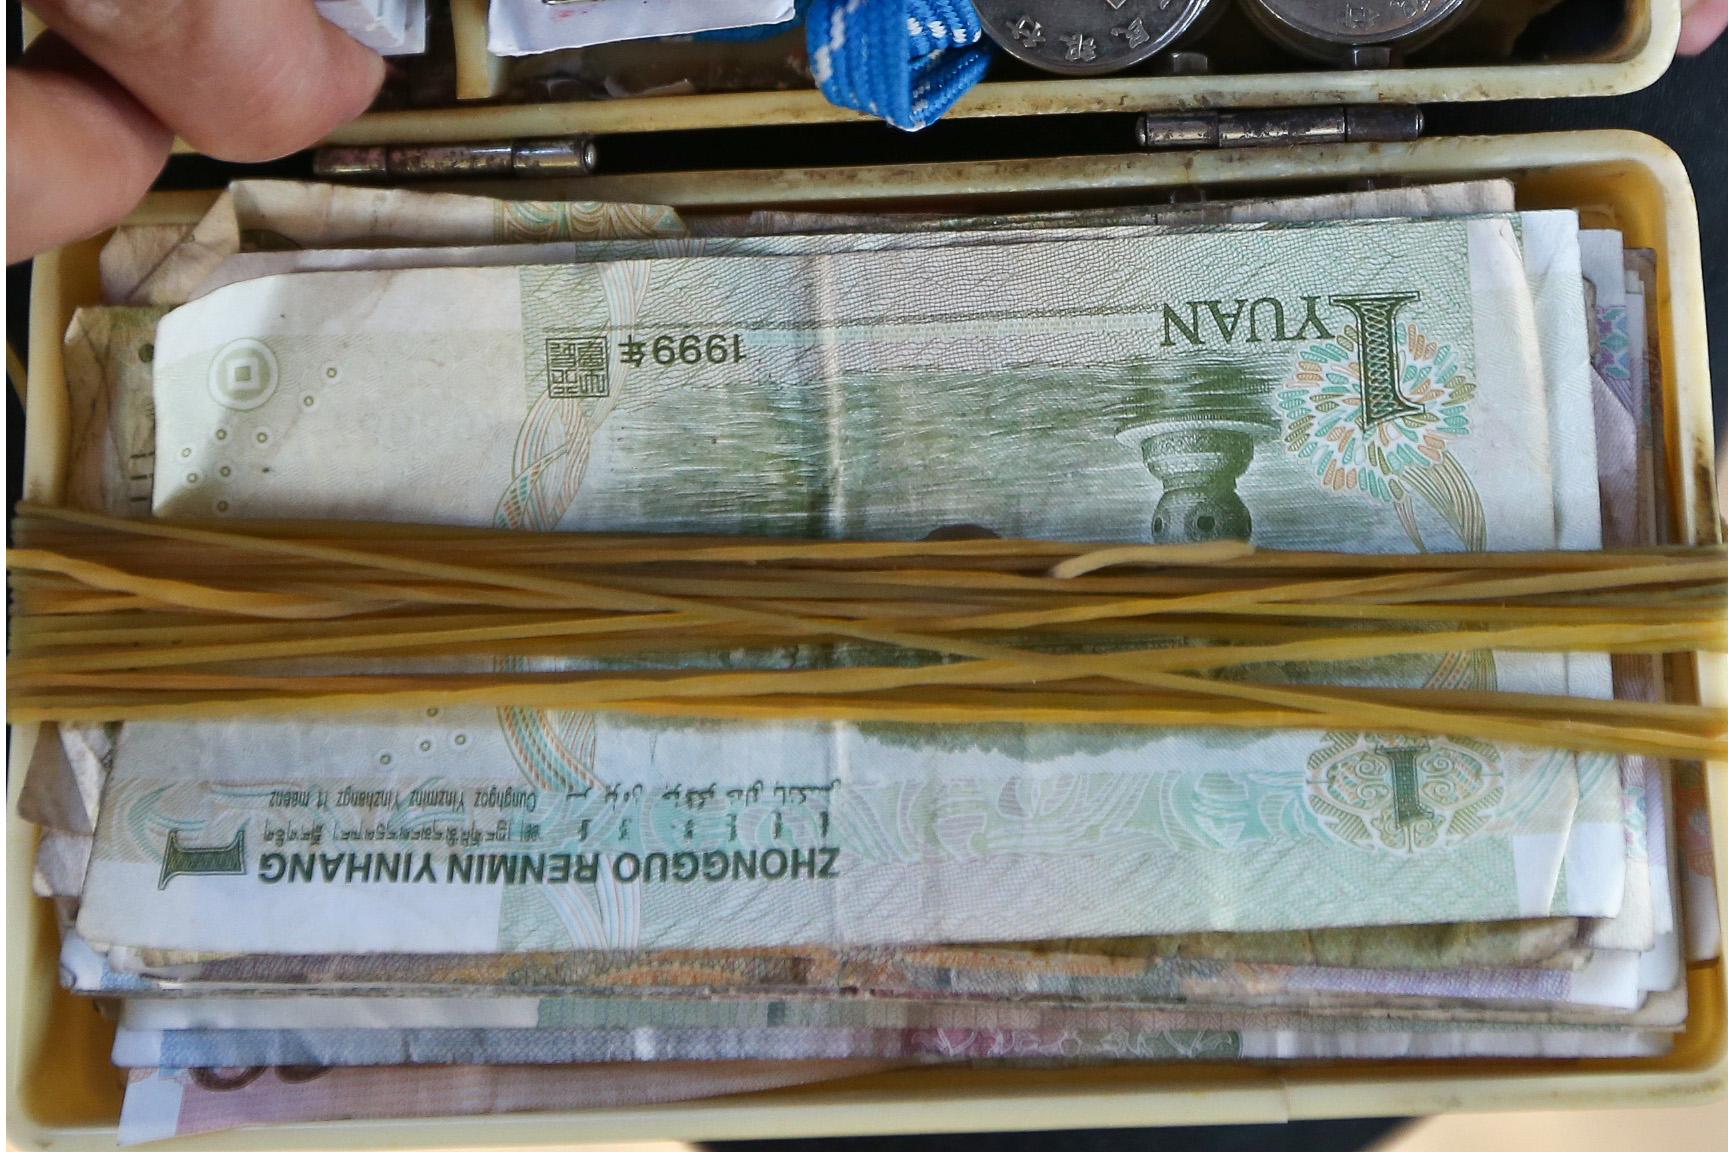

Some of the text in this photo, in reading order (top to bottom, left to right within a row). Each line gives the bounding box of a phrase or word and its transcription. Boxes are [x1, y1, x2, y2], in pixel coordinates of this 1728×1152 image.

[617, 333, 748, 369] 1999年
[1158, 291, 1427, 433] YUAN 1
[257, 847, 841, 886] ZHONGGUO RENMIN YINHANG
